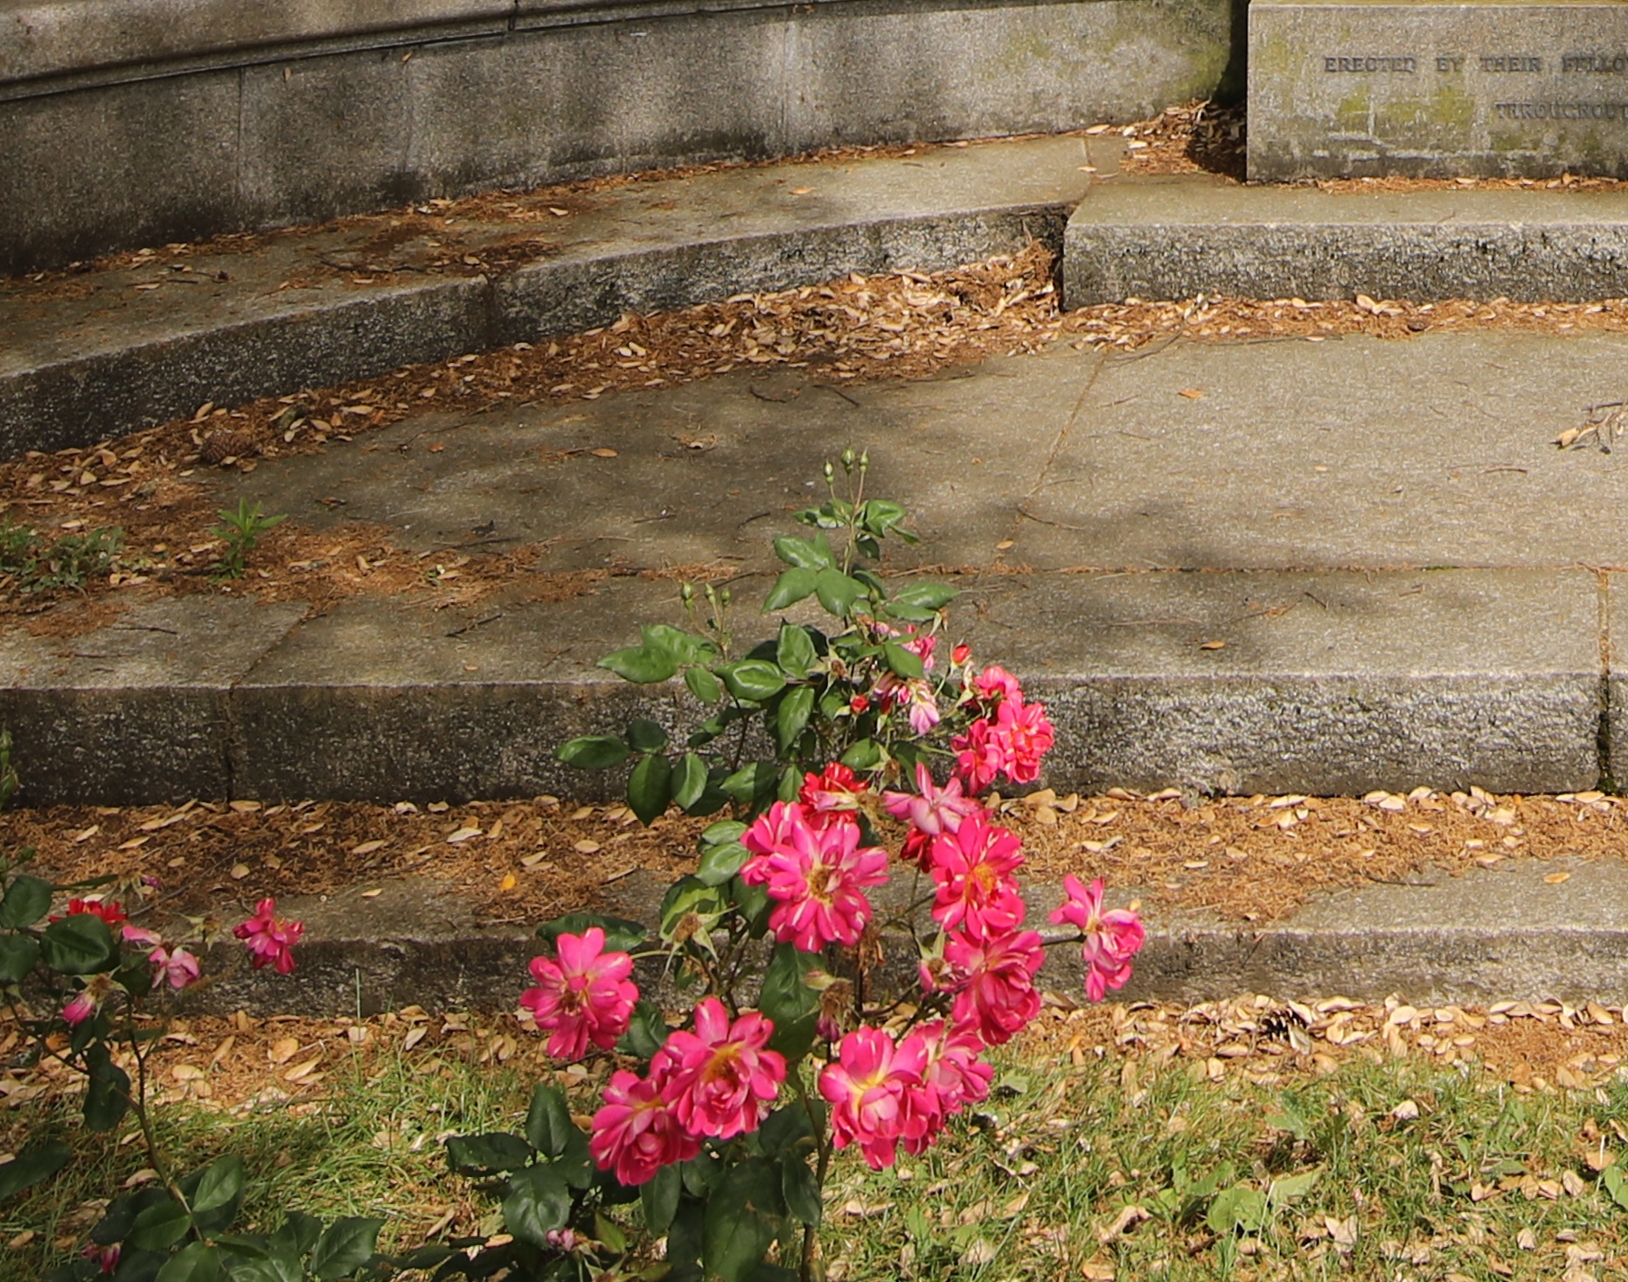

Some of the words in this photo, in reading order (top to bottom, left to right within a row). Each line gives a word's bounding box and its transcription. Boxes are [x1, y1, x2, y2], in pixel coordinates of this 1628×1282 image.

[1323, 56, 1418, 74] ERECTED
[1435, 56, 1465, 74] BY
[1479, 56, 1542, 74] THEIR
